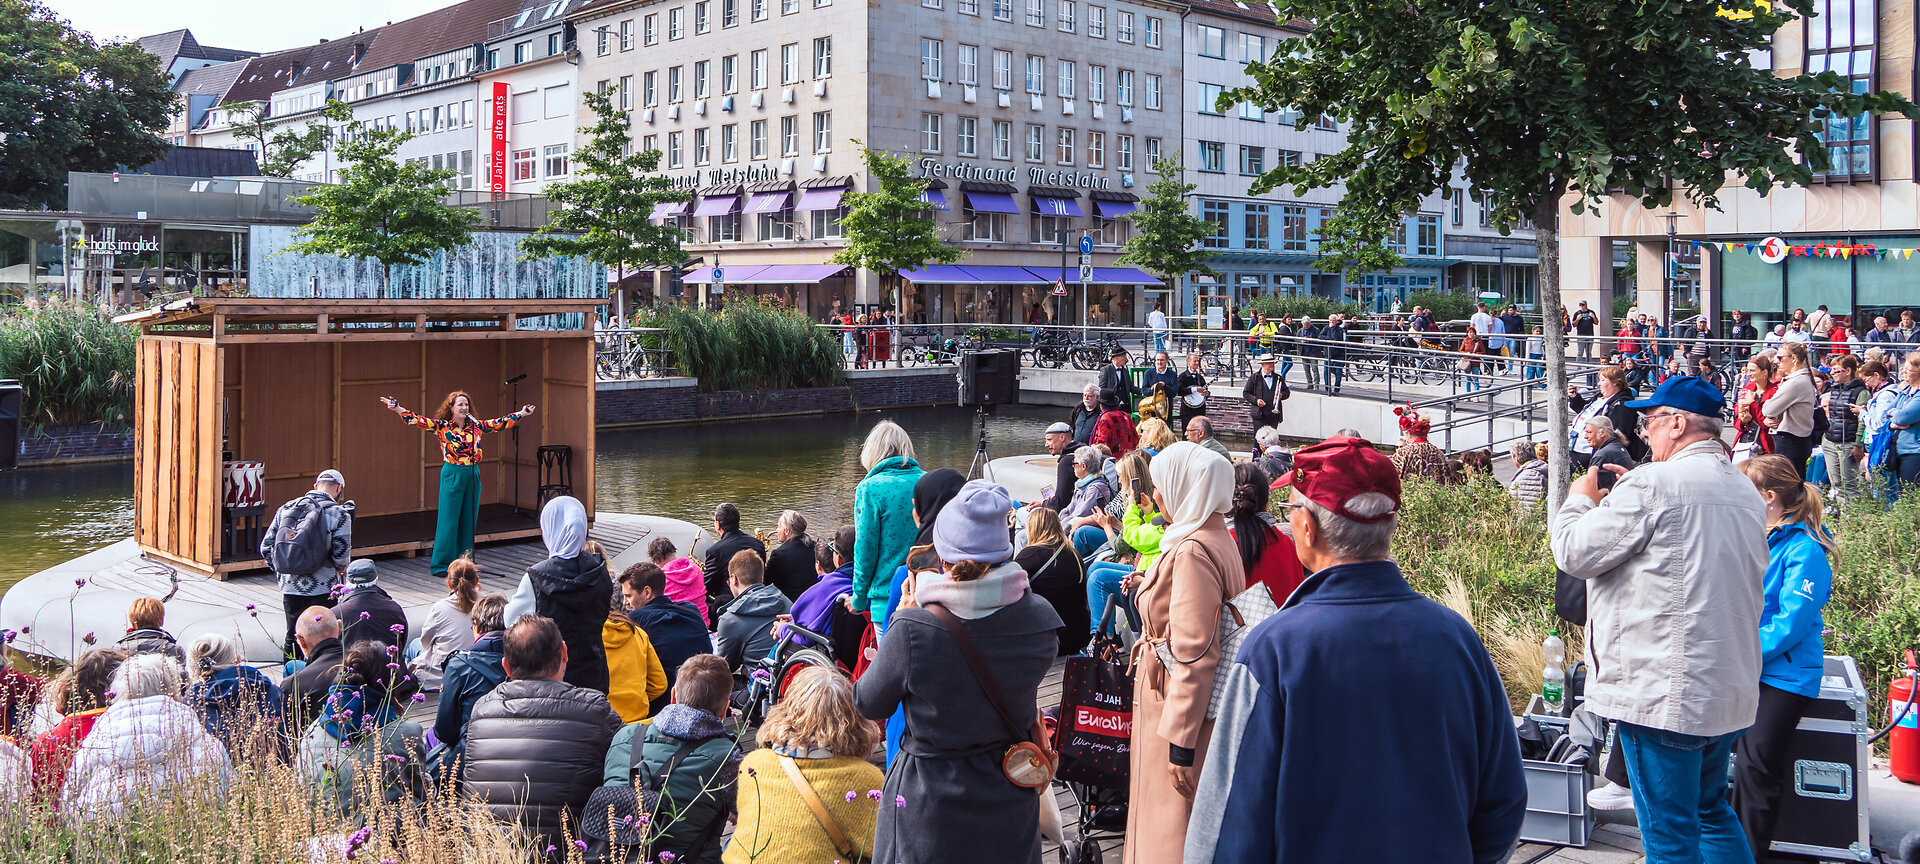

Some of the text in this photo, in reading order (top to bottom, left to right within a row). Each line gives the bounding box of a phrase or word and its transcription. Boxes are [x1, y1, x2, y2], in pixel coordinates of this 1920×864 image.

[495, 95, 504, 116] rats
[493, 119, 504, 140] alte
[493, 150, 503, 179] Jahre
[708, 163, 778, 186] Meislahn
[920, 157, 1111, 190] Ferdinand Meislahn
[90, 234, 160, 255] hans im glück
[1791, 240, 1876, 257] odafone
[1094, 692, 1103, 703] 20
